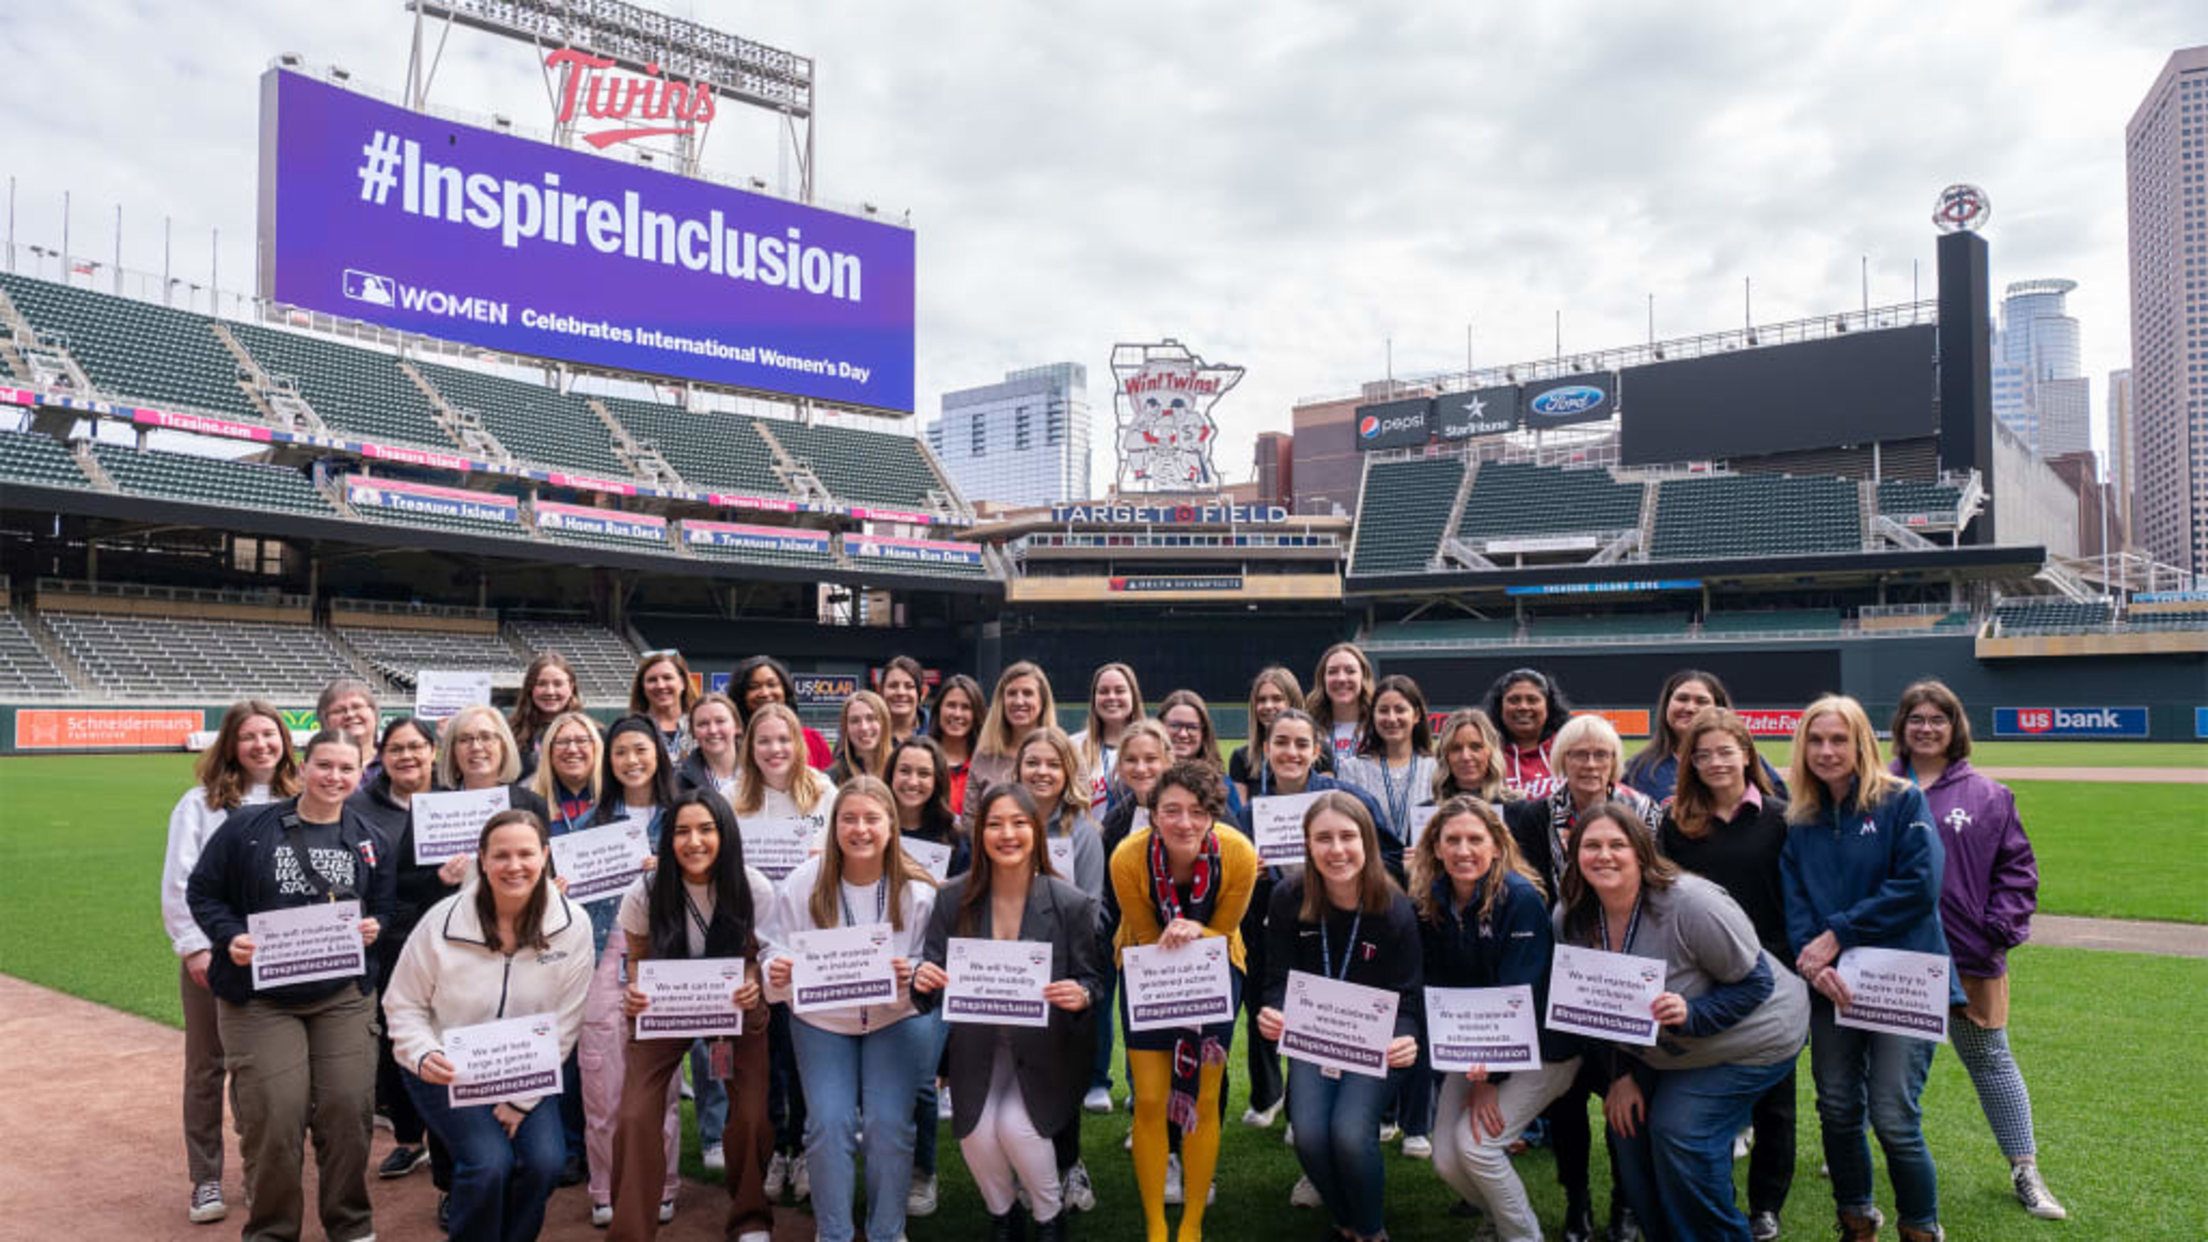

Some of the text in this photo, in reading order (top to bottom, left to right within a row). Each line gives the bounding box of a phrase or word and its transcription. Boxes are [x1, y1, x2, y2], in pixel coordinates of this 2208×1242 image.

[545, 48, 716, 124] Twins
[358, 129, 862, 302] #InspireInclusion
[399, 284, 871, 384] WOMEN Celebrates International Women's Day
[1125, 370, 1222, 395] Win! Twins!
[1546, 390, 1590, 411] Ford
[1381, 411, 1425, 434] pepsi
[427, 453, 461, 470] Island
[390, 495, 506, 521] Treasure Island
[1052, 505, 1288, 523] TARGET FIELD
[566, 516, 662, 540] Home Run Deck
[2019, 708, 2119, 728] us bank
[260, 955, 358, 977] #InspireInclusion
[1860, 969, 1877, 979] We
[1879, 971, 1896, 981] will
[1568, 970, 1583, 980] We
[1586, 973, 1603, 983] will
[655, 982, 671, 992] We
[673, 982, 689, 991] will
[800, 982, 889, 1001] #InspireInclusion
[950, 999, 1042, 1015] #InspireInclusion
[1135, 1000, 1226, 1018] #InspireInclusion
[1299, 997, 1314, 1008] We
[1317, 1002, 1334, 1012] will
[643, 1016, 735, 1029] #InspireInclusion
[1554, 1006, 1651, 1036] #InspireInclusion
[471, 1048, 488, 1058] We
[491, 1044, 508, 1053] will
[1286, 1033, 1379, 1063] #InspireInclusion
[1436, 1046, 1528, 1060] #InspireInclusion
[455, 1074, 553, 1097] #InspireInclusion
